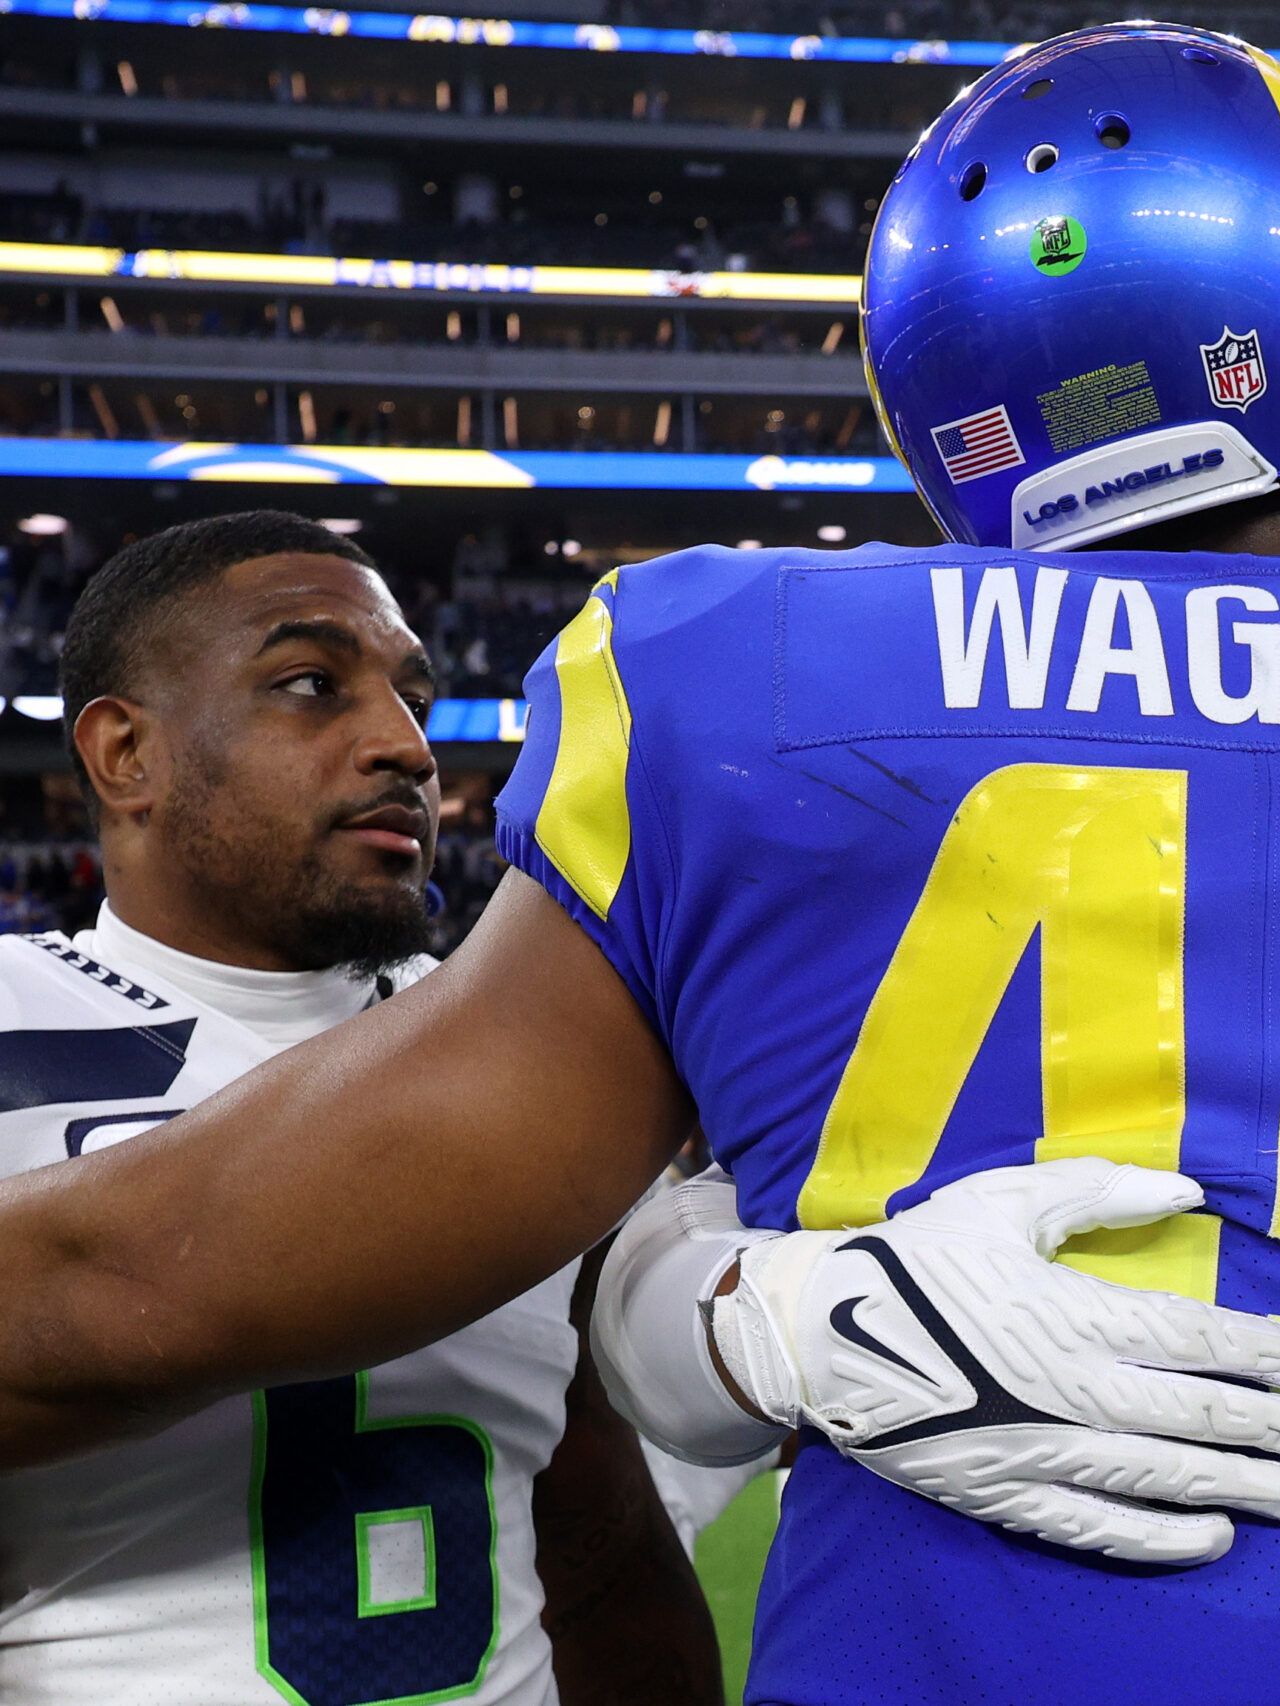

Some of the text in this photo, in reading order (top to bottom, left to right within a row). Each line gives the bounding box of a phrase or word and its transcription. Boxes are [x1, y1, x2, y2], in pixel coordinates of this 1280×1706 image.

[1045, 230, 1069, 250] NFL
[1060, 364, 1117, 387] WARNING
[1214, 363, 1260, 399] NFL
[1023, 448, 1224, 526] LOS ANGELES
[250, 1370, 500, 1706] 6
